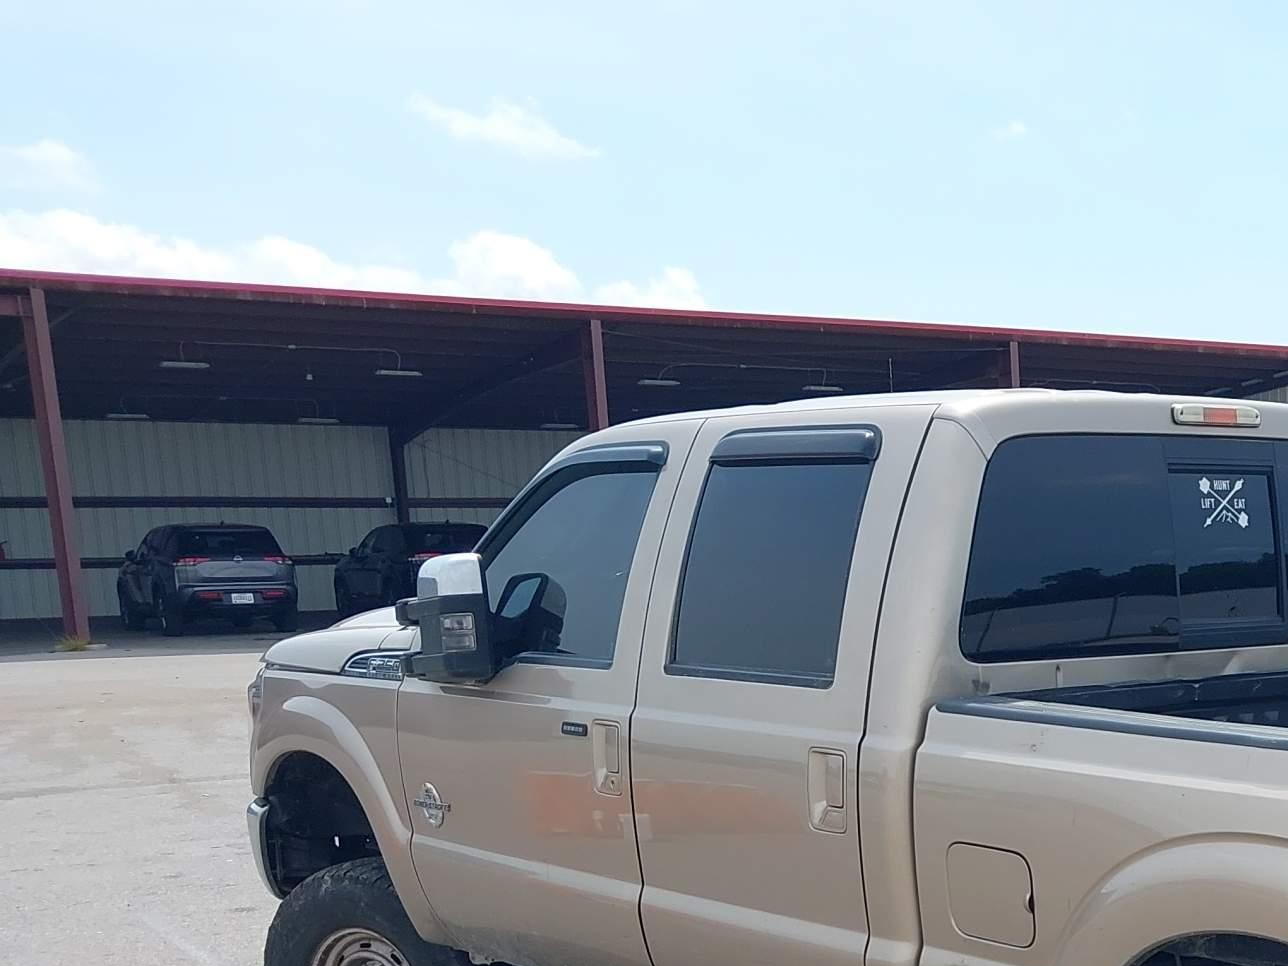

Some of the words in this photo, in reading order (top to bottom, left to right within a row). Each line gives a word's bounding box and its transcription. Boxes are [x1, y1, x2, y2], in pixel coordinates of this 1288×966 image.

[1213, 479, 1230, 490] HUNT
[1201, 498, 1215, 509] LIFT
[1233, 498, 1246, 509] EAT
